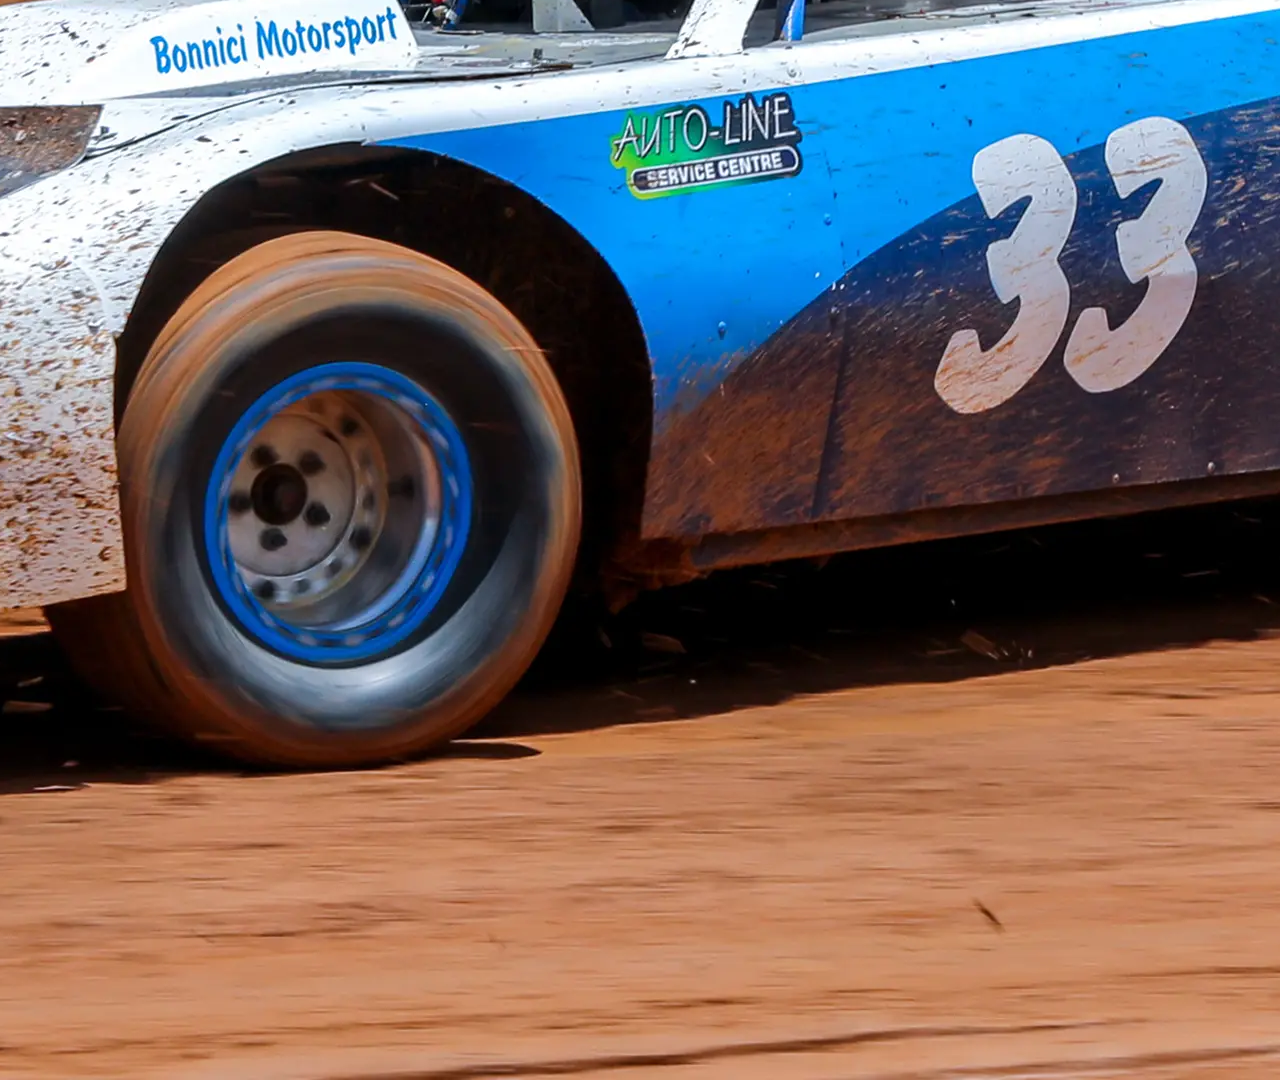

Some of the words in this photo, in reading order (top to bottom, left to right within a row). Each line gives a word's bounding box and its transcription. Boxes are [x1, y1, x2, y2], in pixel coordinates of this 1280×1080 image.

[150, 24, 248, 74] Bonnici
[255, 6, 398, 60] Motorsport
[612, 95, 797, 161] AUTO-LINE
[646, 163, 716, 189] SERVICE
[717, 152, 783, 177] CENTRE
[933, 115, 1209, 415] 33
